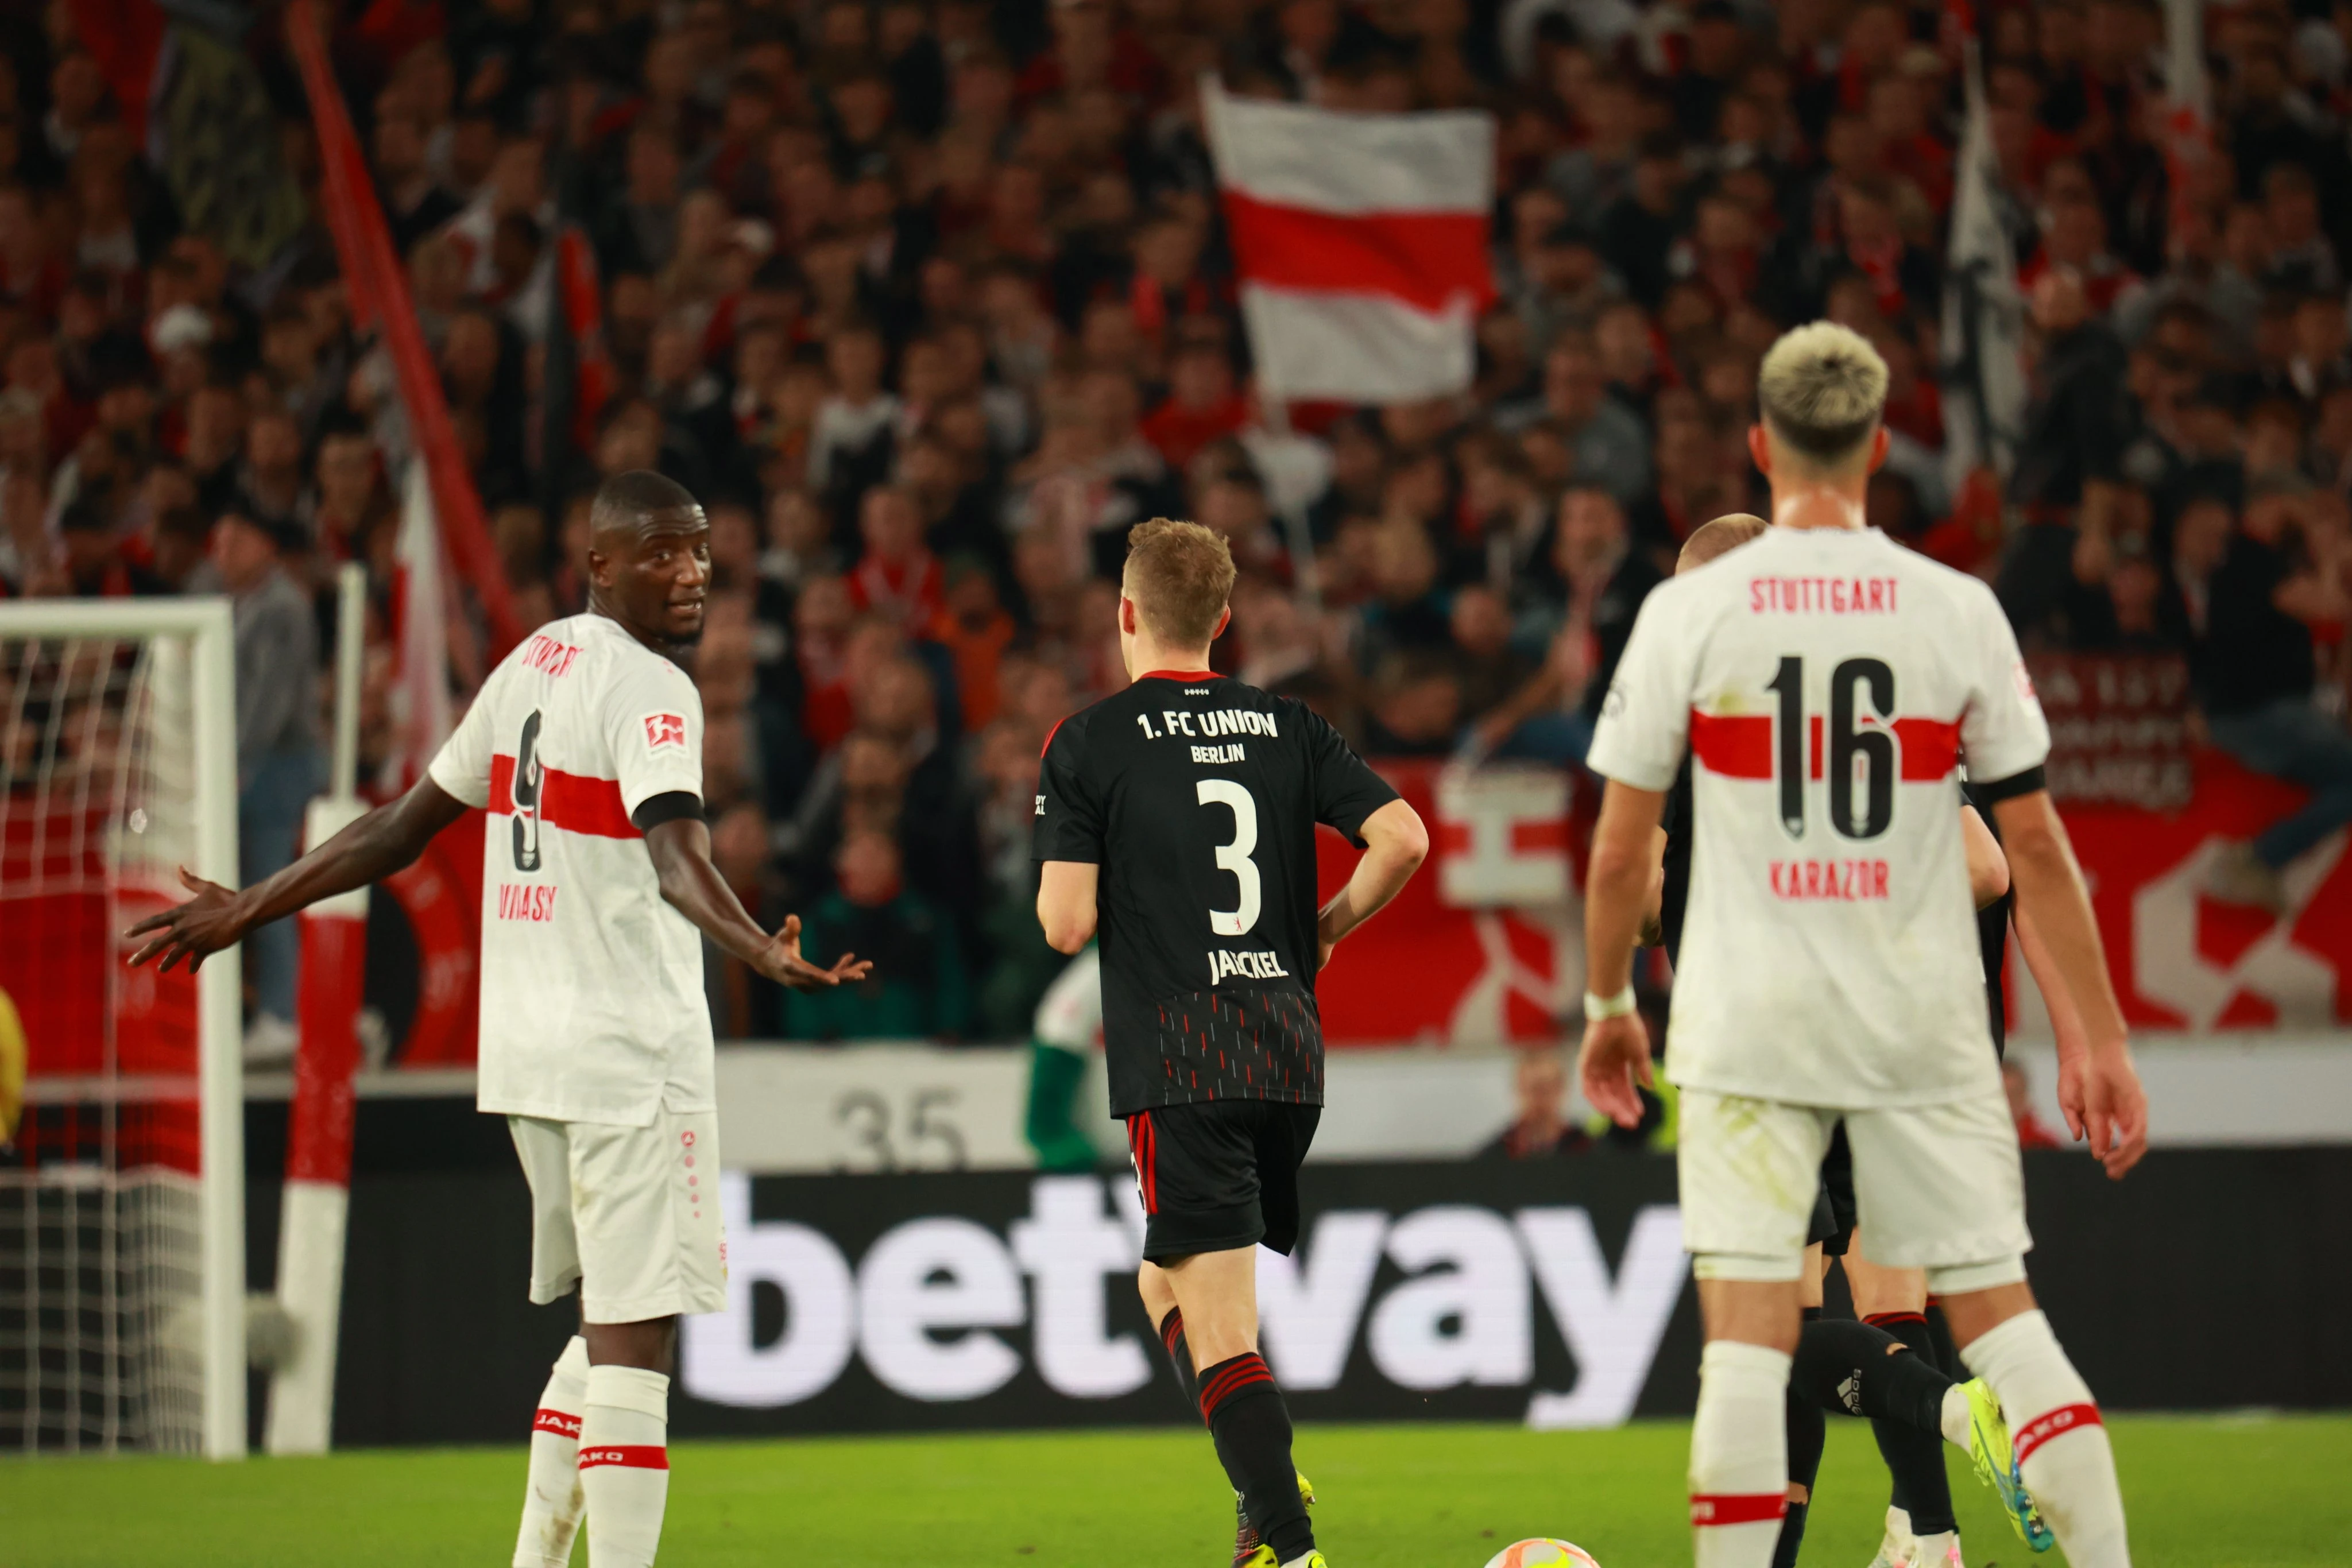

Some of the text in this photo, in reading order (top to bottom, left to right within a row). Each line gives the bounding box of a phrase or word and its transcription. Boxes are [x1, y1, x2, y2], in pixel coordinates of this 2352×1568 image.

[1749, 578, 1898, 615] STUTTGART
[1136, 708, 1278, 740] 1. FC UNION
[1190, 743, 1245, 764] BERLIN
[1765, 656, 1896, 841] 16
[1196, 779, 1262, 936] 3
[1770, 859, 1890, 900] KARAZOR
[682, 1169, 1690, 1431] betway
[537, 1414, 581, 1433] JAK
[2017, 1410, 2075, 1454] AKO
[578, 1451, 624, 1464] AKO
